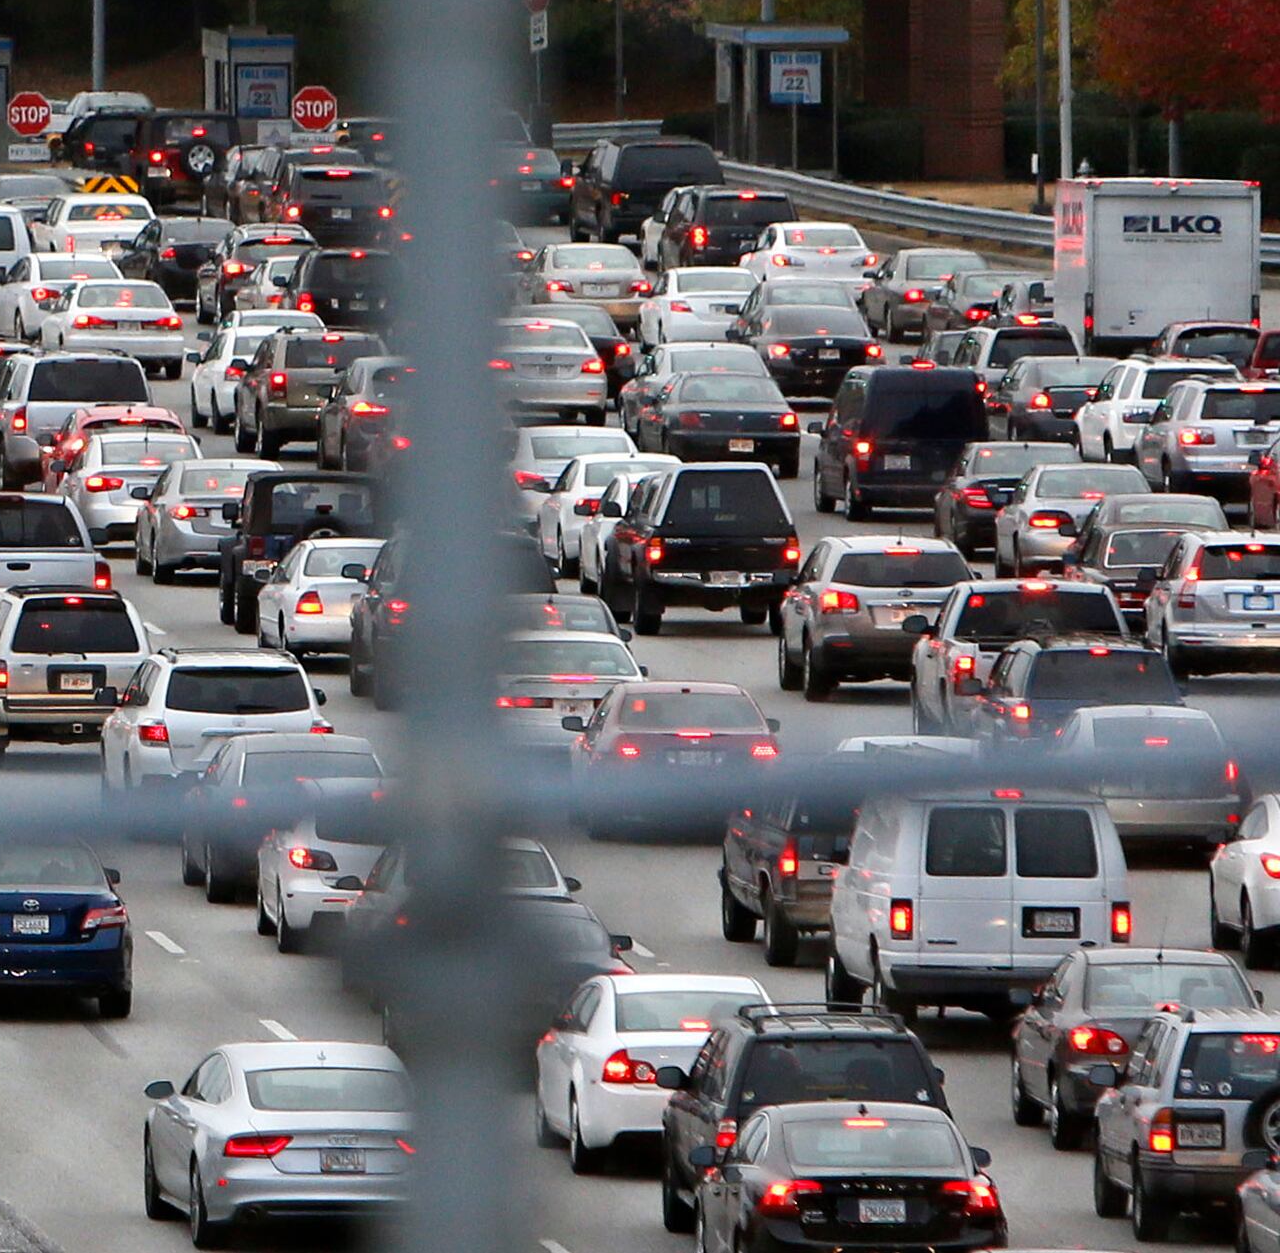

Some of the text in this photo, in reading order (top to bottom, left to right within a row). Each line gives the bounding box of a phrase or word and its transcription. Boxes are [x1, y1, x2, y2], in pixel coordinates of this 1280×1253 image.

[784, 77, 805, 91] 22
[253, 91, 273, 105] 22
[10, 106, 49, 124] STOP
[296, 100, 334, 118] STOP
[1151, 215, 1223, 235] LKQ
